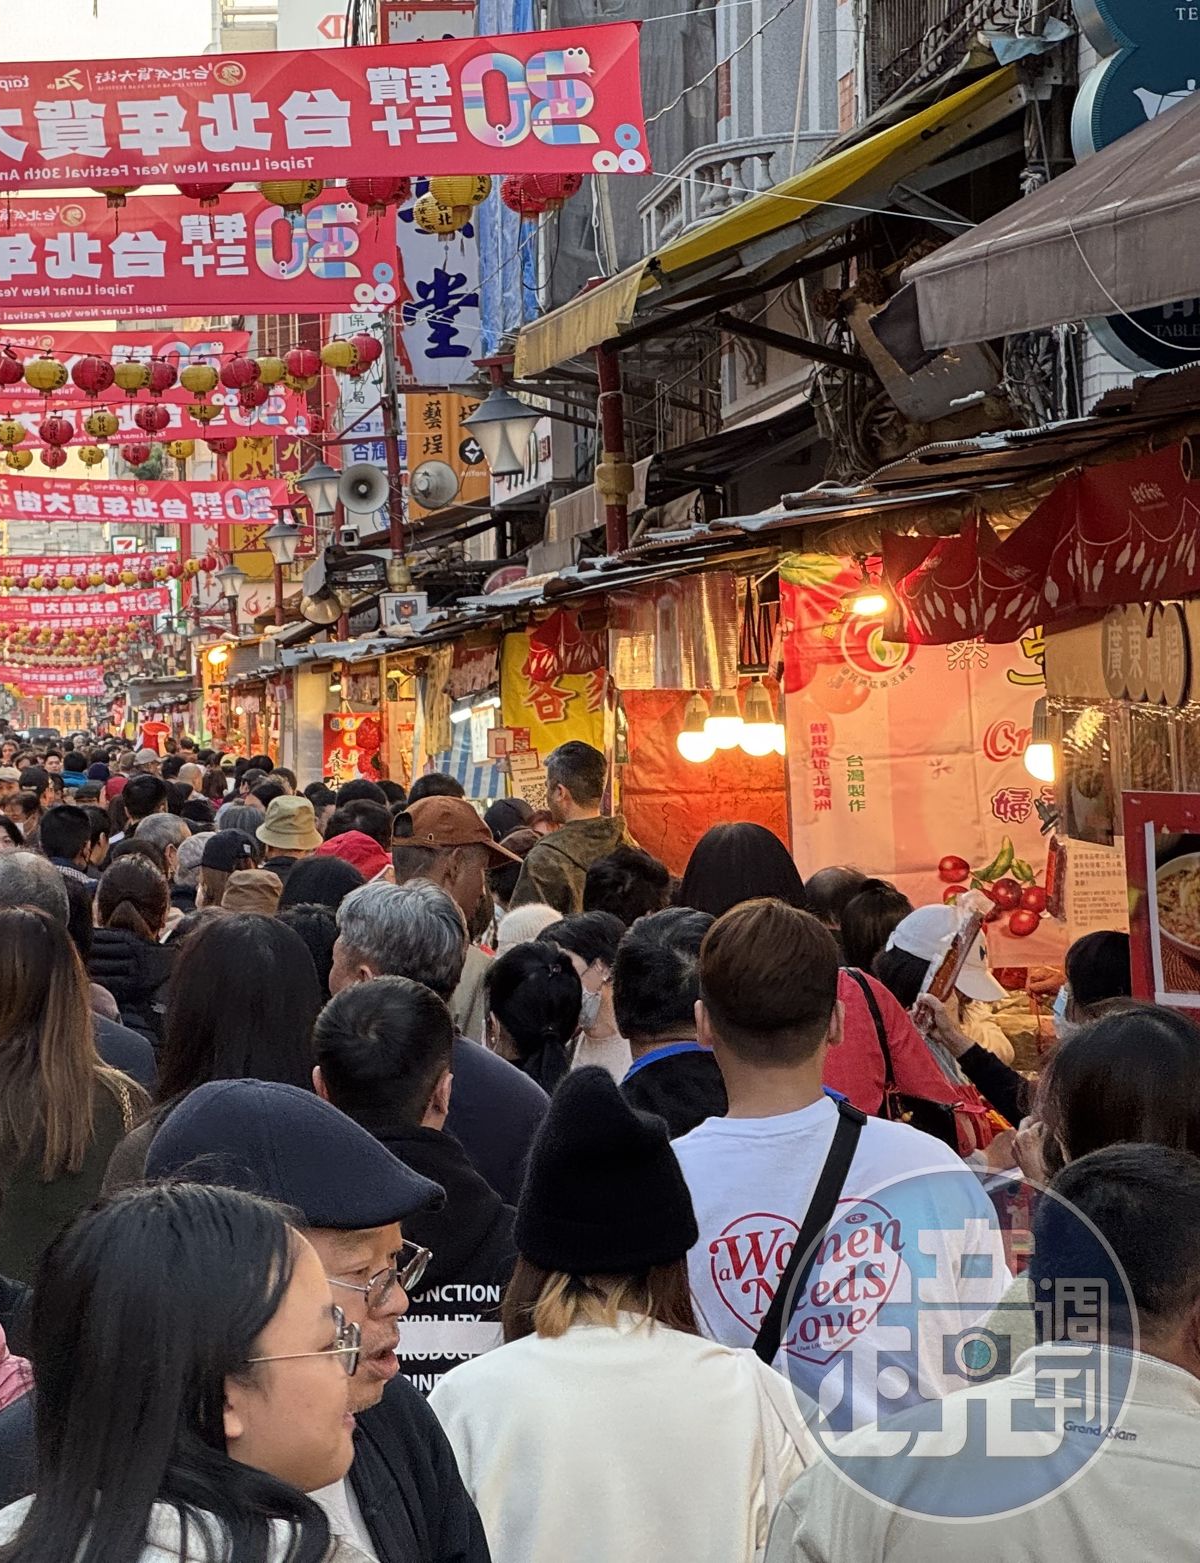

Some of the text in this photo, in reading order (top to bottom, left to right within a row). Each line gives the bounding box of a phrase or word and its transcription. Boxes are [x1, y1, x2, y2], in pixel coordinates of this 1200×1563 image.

[422, 393, 443, 455] 藝埕
[983, 721, 1036, 763] Cr
[846, 755, 866, 812] 台灣製作
[719, 1268, 732, 1281] a
[741, 1262, 887, 1315] Neds
[1063, 1419, 1102, 1438] Grand
